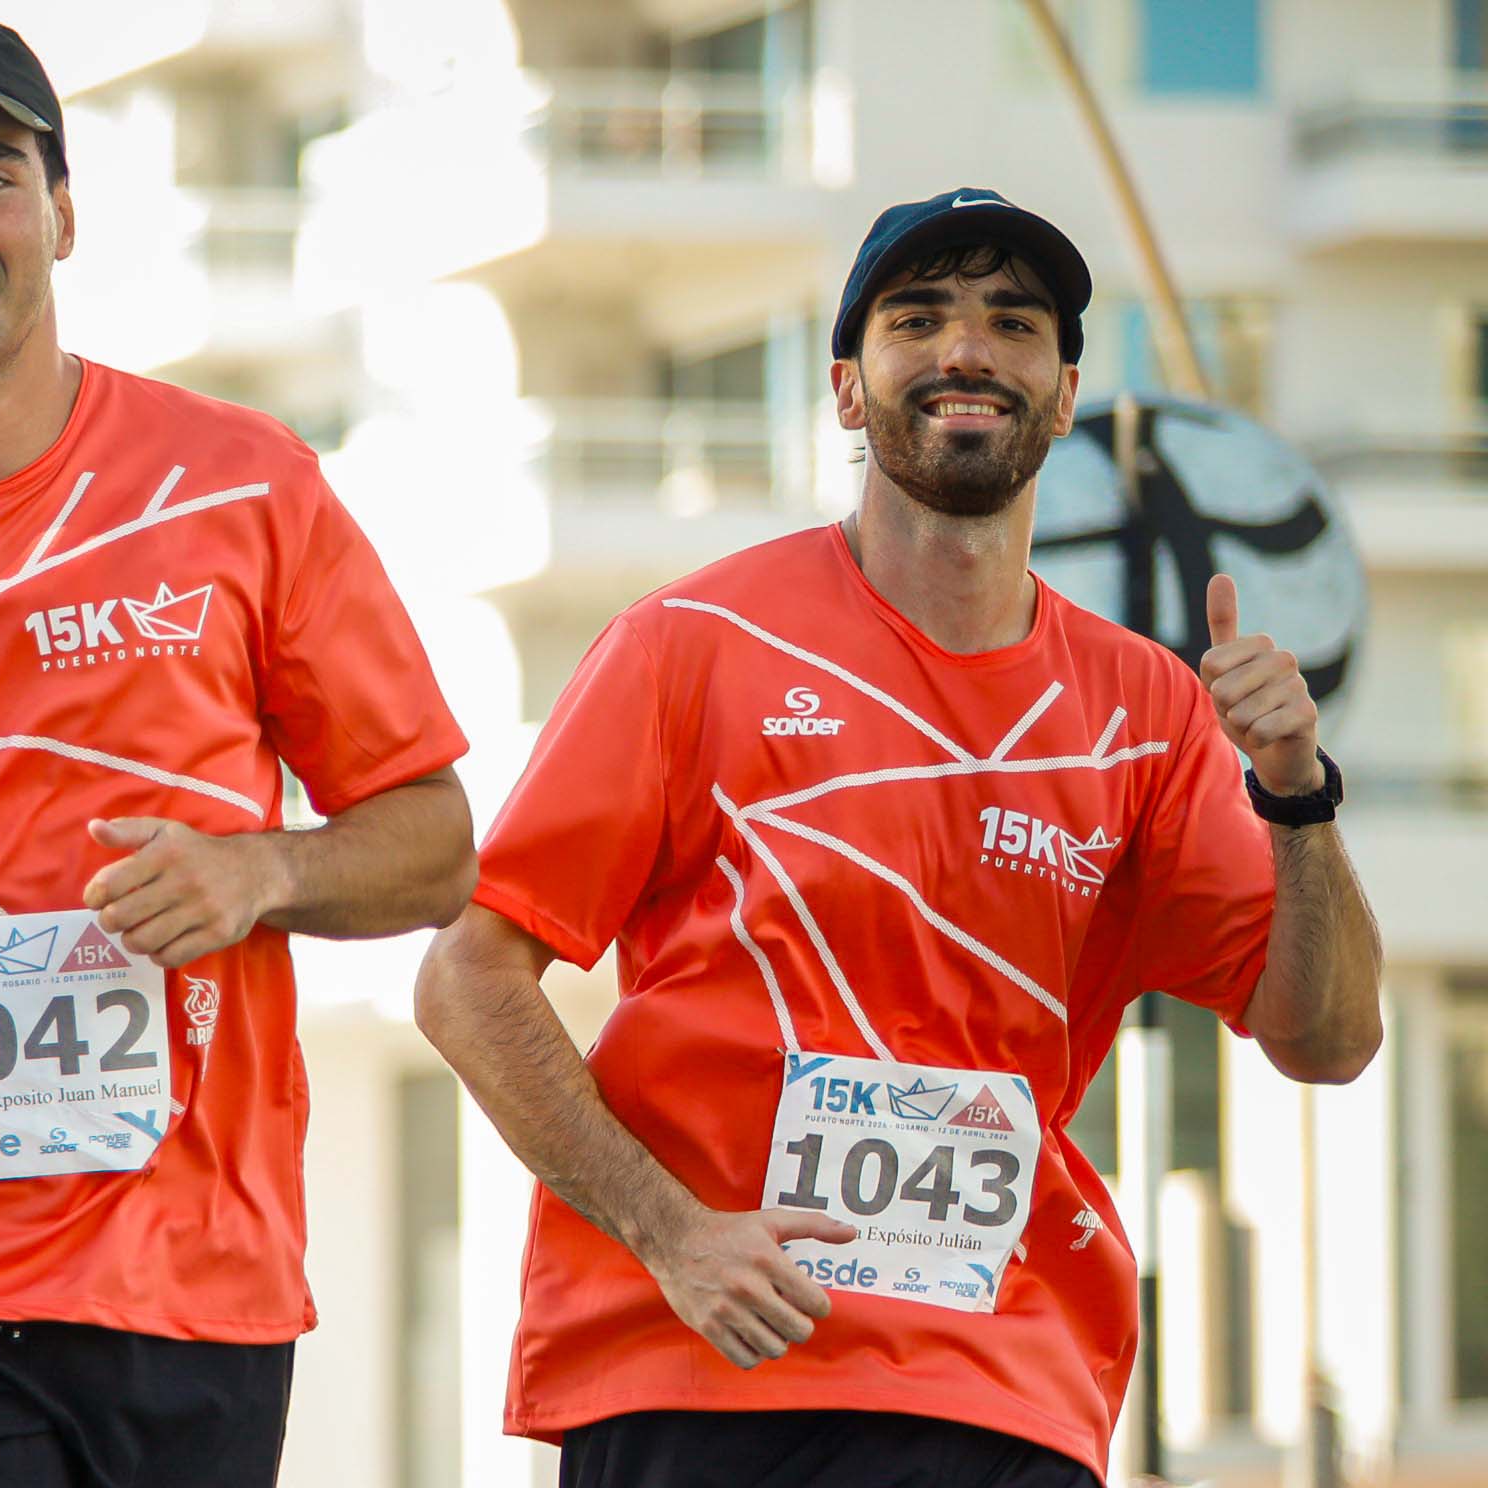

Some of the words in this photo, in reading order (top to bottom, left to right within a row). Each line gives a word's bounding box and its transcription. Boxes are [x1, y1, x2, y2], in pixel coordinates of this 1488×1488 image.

[24, 598, 125, 656] 15K
[41, 649, 127, 672] PUERTO
[135, 644, 201, 657] NORTE
[979, 806, 1060, 867] 15K
[980, 854, 1057, 882] PUERTO
[1061, 876, 1101, 900] NORT
[74, 944, 114, 965] 15K
[3, 978, 41, 990] ROSARIO
[63, 975, 75, 984] DE
[78, 973, 103, 982] ABRIL
[186, 1023, 216, 1046] ARD
[58, 1087, 96, 1103] Juan
[101, 1079, 162, 1100] Manuel
[809, 1076, 881, 1116] 15K
[805, 1114, 837, 1124] PUERTO
[839, 1118, 866, 1127] NORTE
[895, 1123, 929, 1133] ROSARIO
[949, 1128, 959, 1136] DE
[962, 1129, 986, 1139] ABRIL
[966, 1106, 1001, 1125] 15K
[88, 1132, 132, 1144] POWER
[777, 1133, 1021, 1228] 1043
[867, 1225, 933, 1247] Expósito
[937, 1231, 983, 1250] Julián
[939, 1280, 981, 1293] POWER
